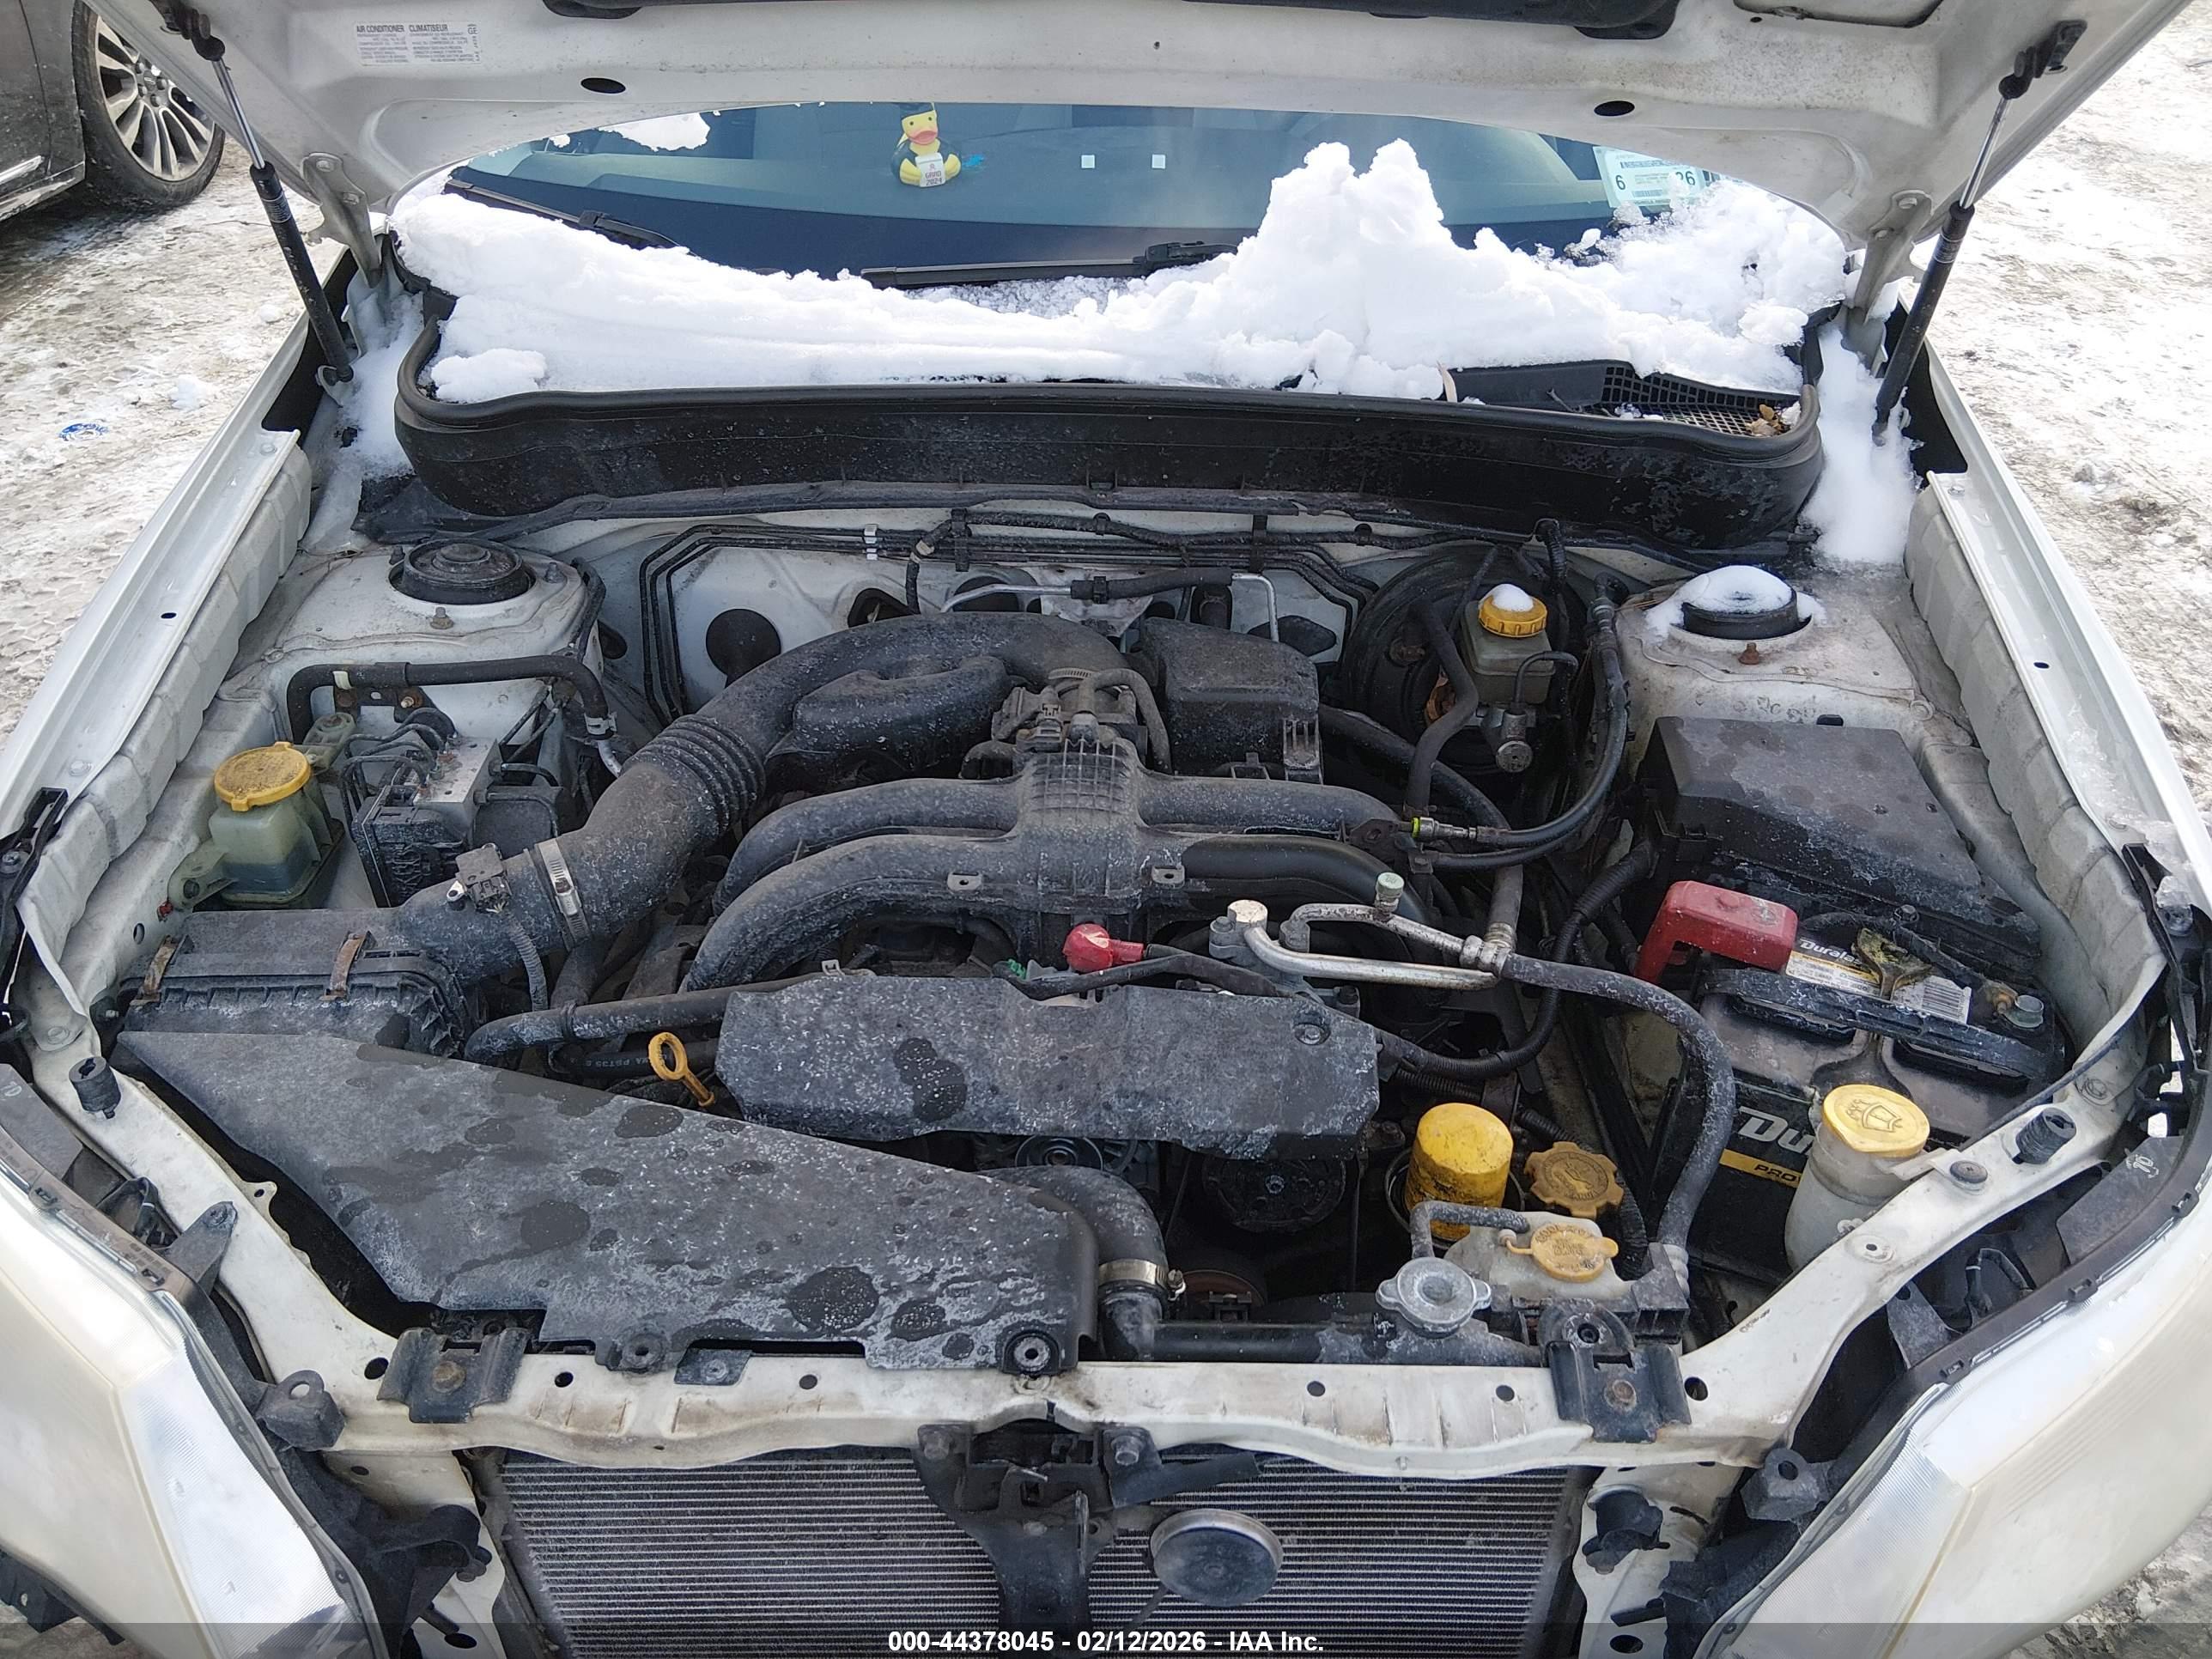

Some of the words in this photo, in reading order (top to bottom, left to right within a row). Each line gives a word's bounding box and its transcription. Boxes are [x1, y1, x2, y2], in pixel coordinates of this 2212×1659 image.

[367, 24, 405, 33] CONDITIONER
[409, 23, 448, 33] CLIMATISEUR
[1615, 174, 1626, 191] 6
